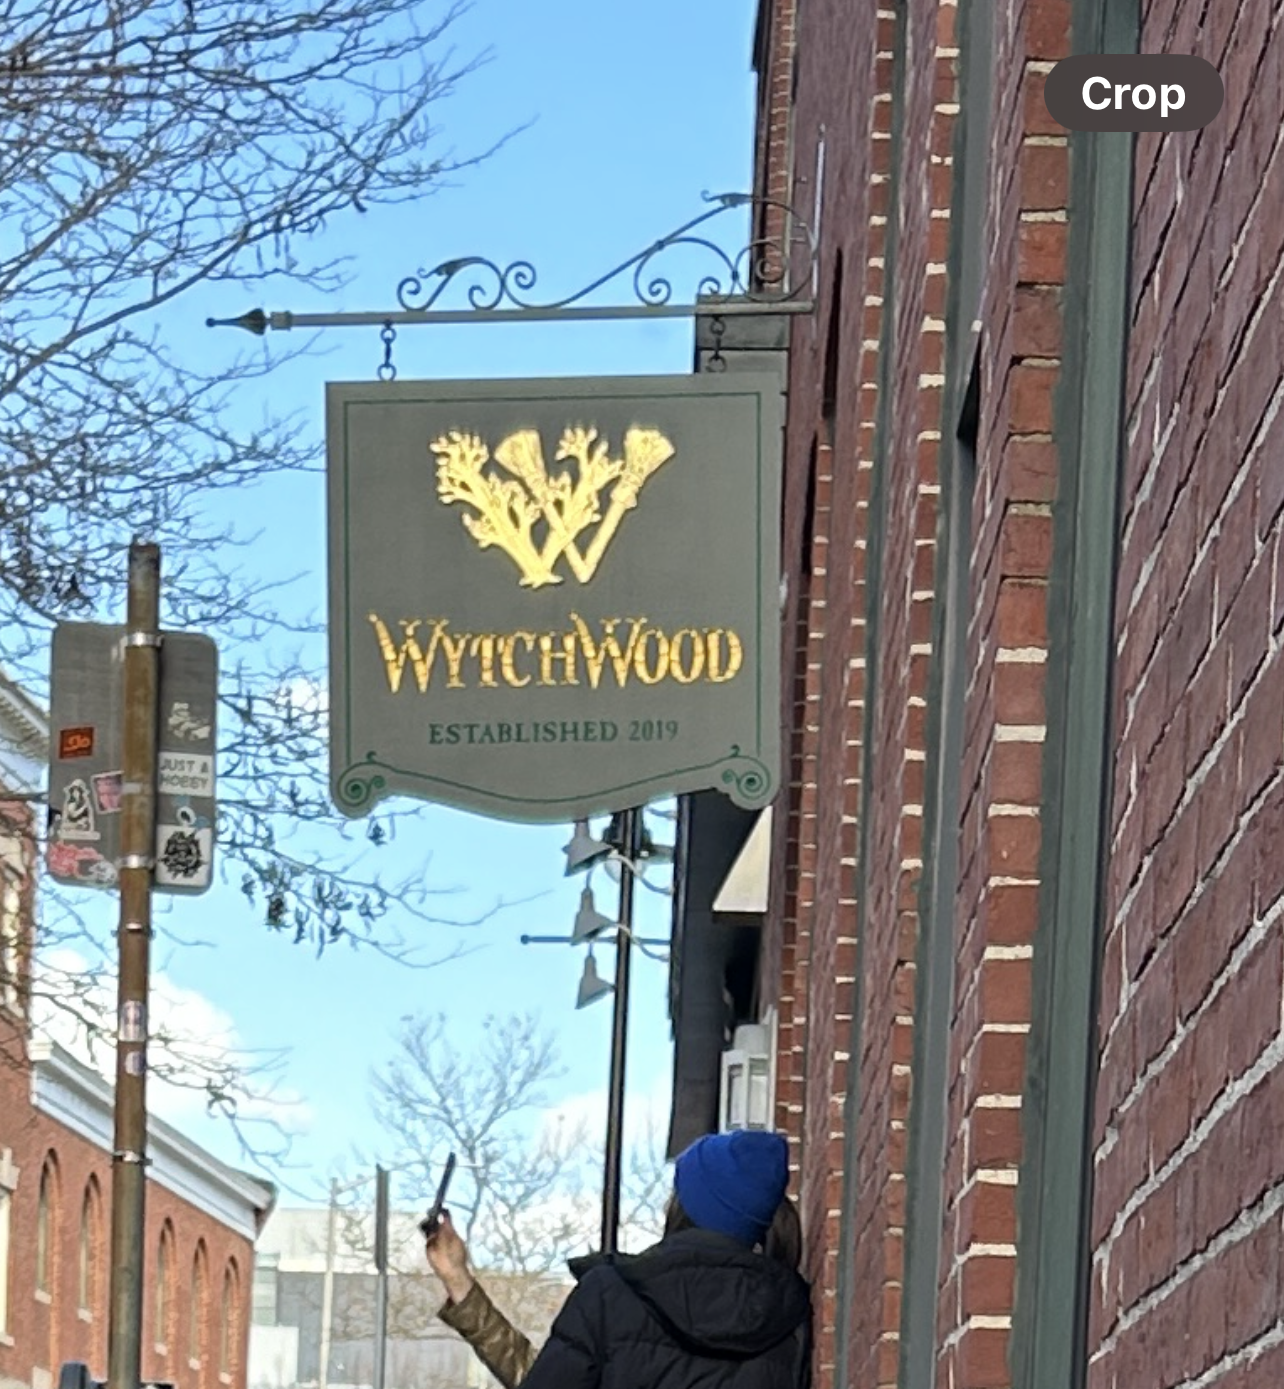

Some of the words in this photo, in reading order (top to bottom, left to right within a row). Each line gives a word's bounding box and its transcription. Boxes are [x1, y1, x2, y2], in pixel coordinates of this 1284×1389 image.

[428, 721, 619, 745] ESTABLISHED
[629, 720, 679, 742] 2019
[160, 759, 195, 772] JUST
[201, 762, 209, 773] A
